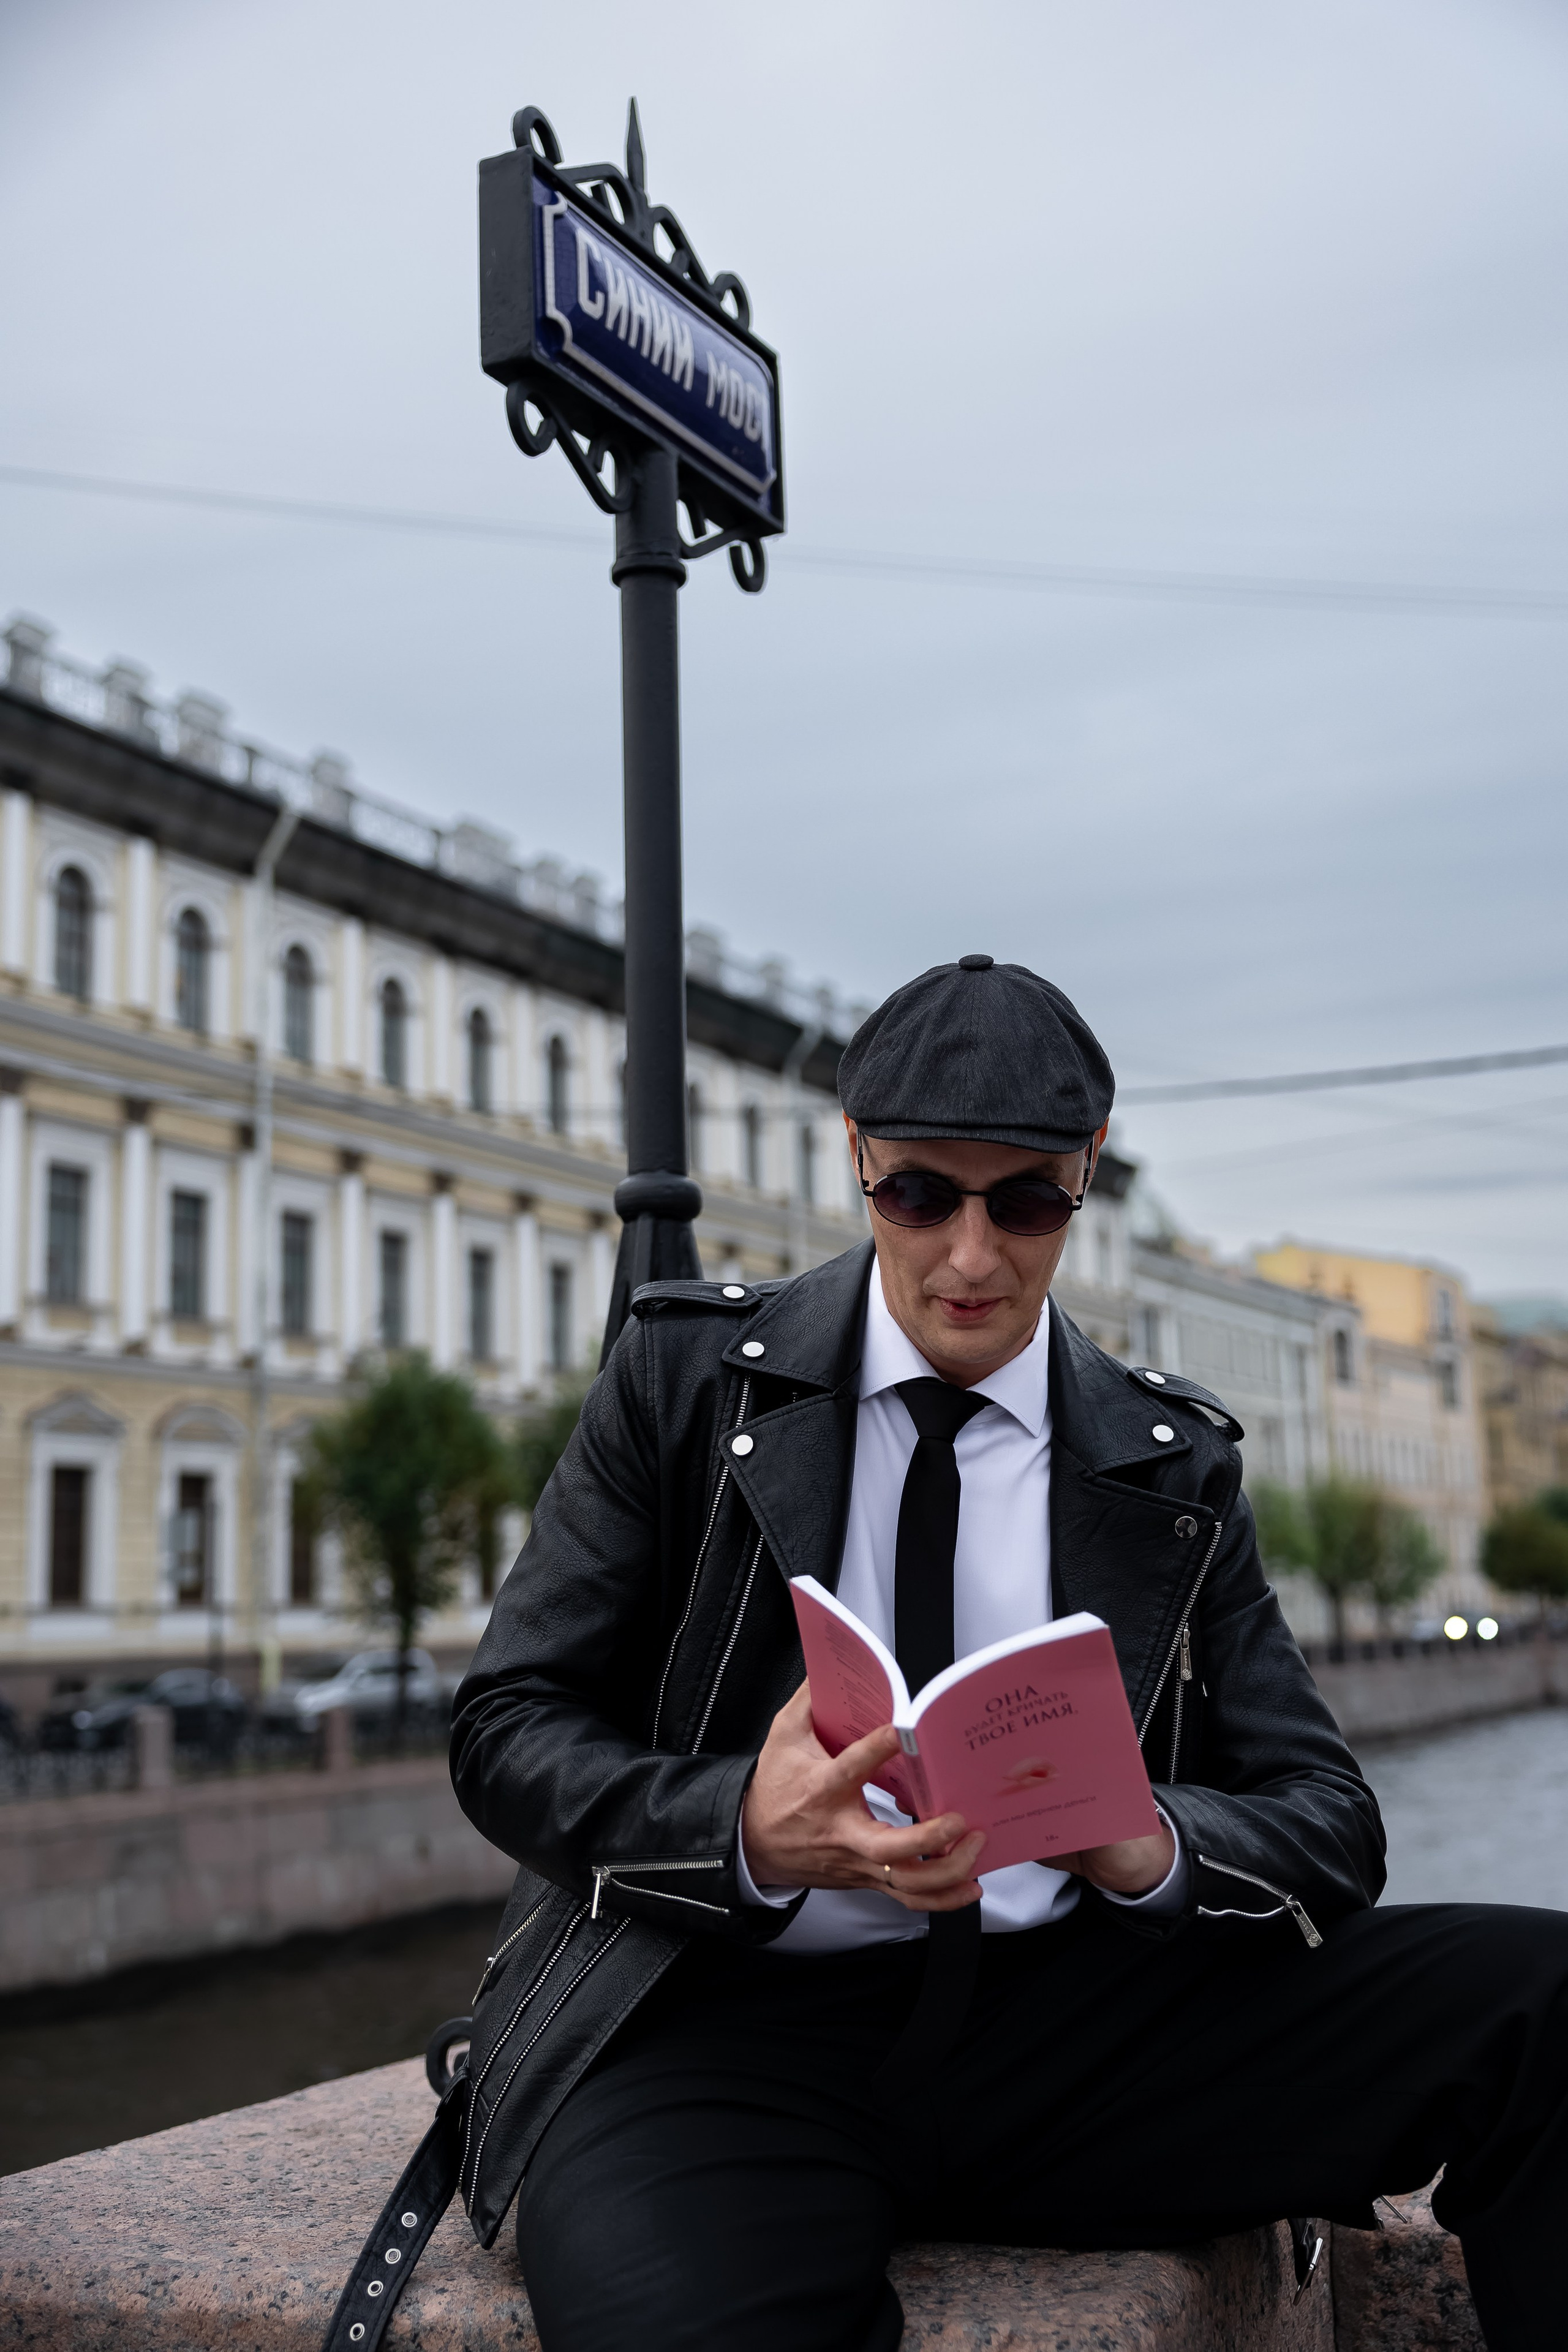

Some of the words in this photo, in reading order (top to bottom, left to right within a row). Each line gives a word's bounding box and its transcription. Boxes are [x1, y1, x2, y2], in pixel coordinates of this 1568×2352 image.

[964, 1712, 1003, 1738] БУДЕТ
[1007, 1691, 1069, 1717] КРИЧАТЬ
[984, 1684, 1039, 1714] ОНА
[964, 1719, 1018, 1752] ТВОЕ
